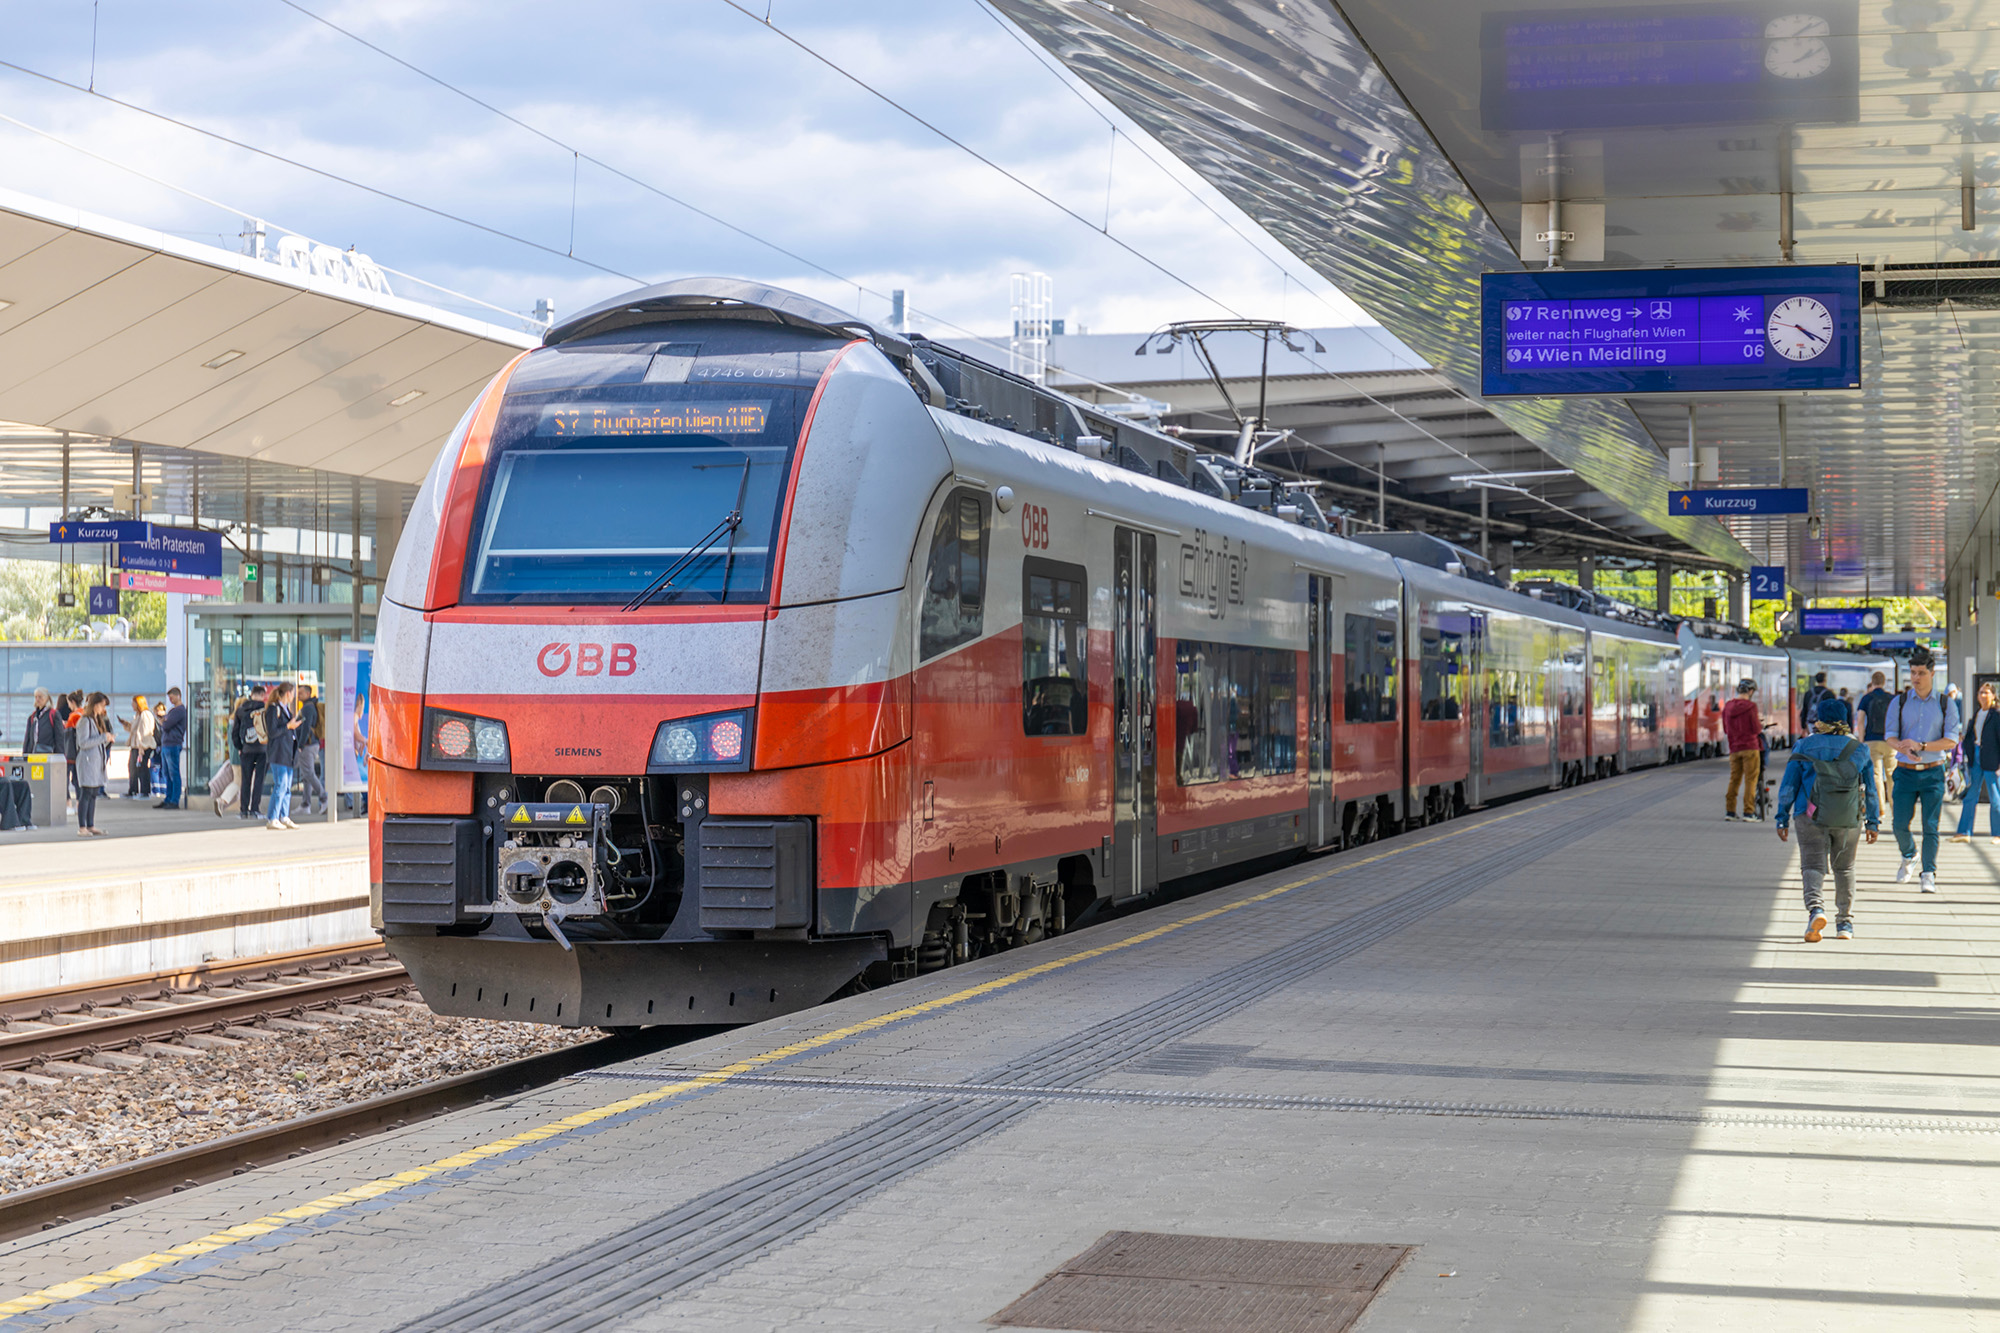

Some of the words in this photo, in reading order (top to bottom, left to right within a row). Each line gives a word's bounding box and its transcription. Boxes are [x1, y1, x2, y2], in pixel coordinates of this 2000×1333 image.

[1537, 307, 1622, 322] Rennweg
[1506, 329, 1545, 341] weiter
[1548, 328, 1580, 340] nach
[1584, 327, 1649, 342] Flughafen
[1652, 326, 1686, 338] Wien
[1537, 348, 1582, 362] Wien
[1589, 346, 1667, 364] Meidling
[1743, 344, 1765, 358] 06
[698, 367, 745, 378] 4746
[753, 367, 786, 378] 015
[555, 410, 580, 435] S7
[594, 409, 682, 436] Flughafen
[1705, 497, 1757, 510] Kurzzug
[78, 528, 118, 539] Kurzzug
[1021, 502, 1049, 550] ÖBB
[162, 535, 205, 554] Praterstern
[1179, 528, 1248, 620] cityjet
[1756, 575, 1768, 592] 2
[1770, 582, 1779, 592] B
[93, 593, 104, 609] 4
[536, 642, 638, 678] ÖBB
[554, 747, 602, 757] SIEMENS
